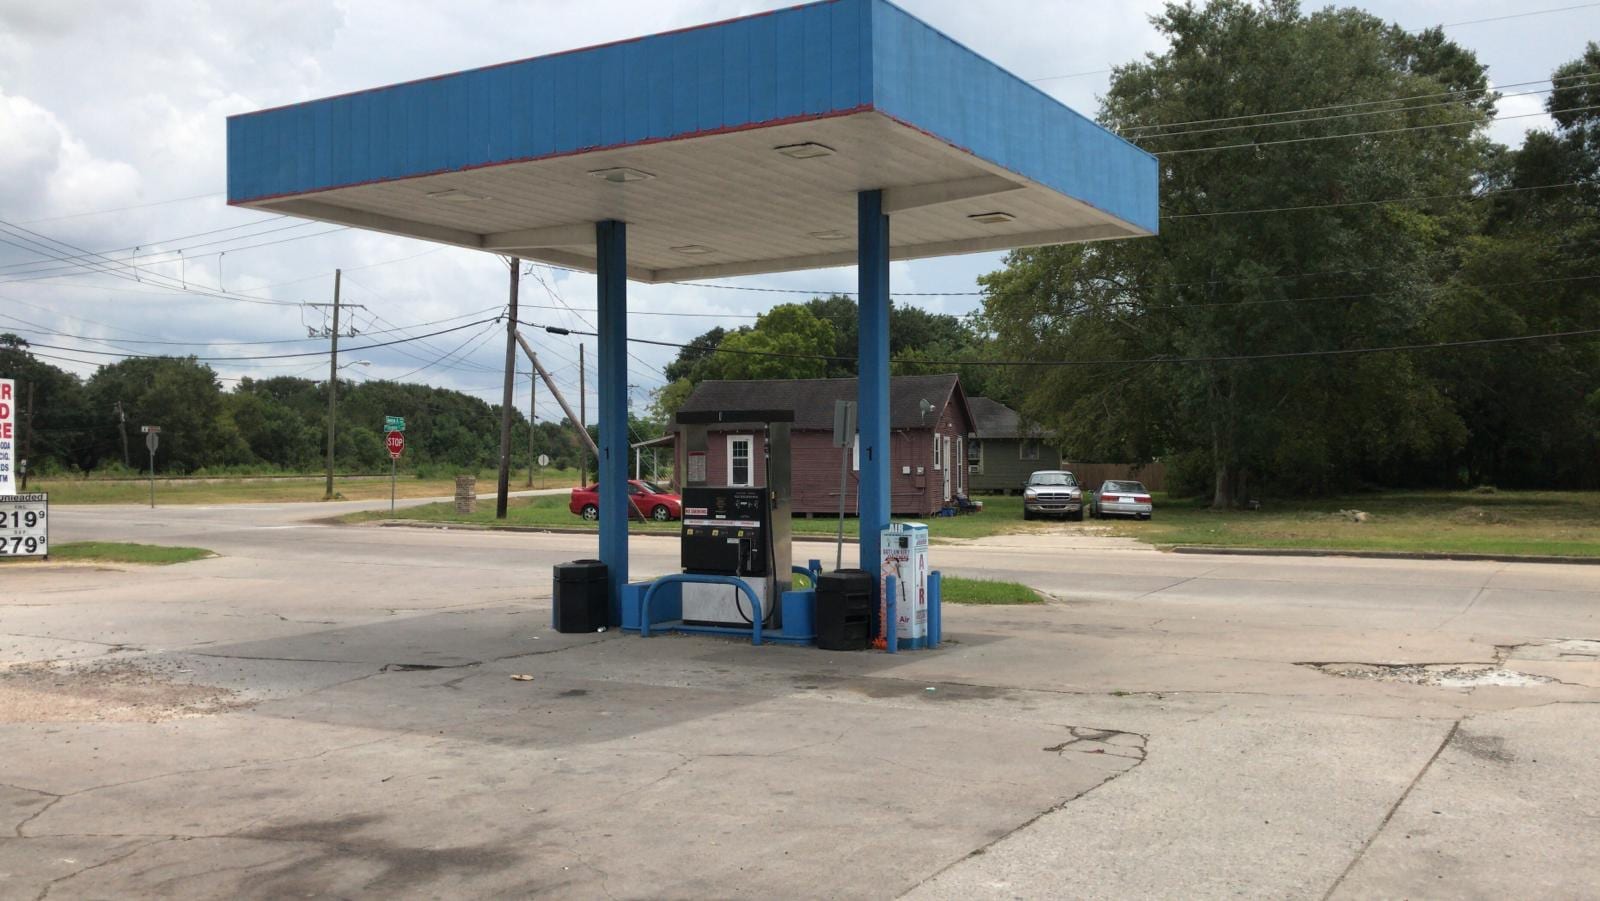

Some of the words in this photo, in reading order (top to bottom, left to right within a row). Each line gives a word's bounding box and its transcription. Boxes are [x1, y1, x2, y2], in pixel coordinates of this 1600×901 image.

[0, 423, 12, 438] E
[388, 438, 402, 446] STOP
[866, 447, 872, 461] 1
[890, 524, 904, 533] AIR
